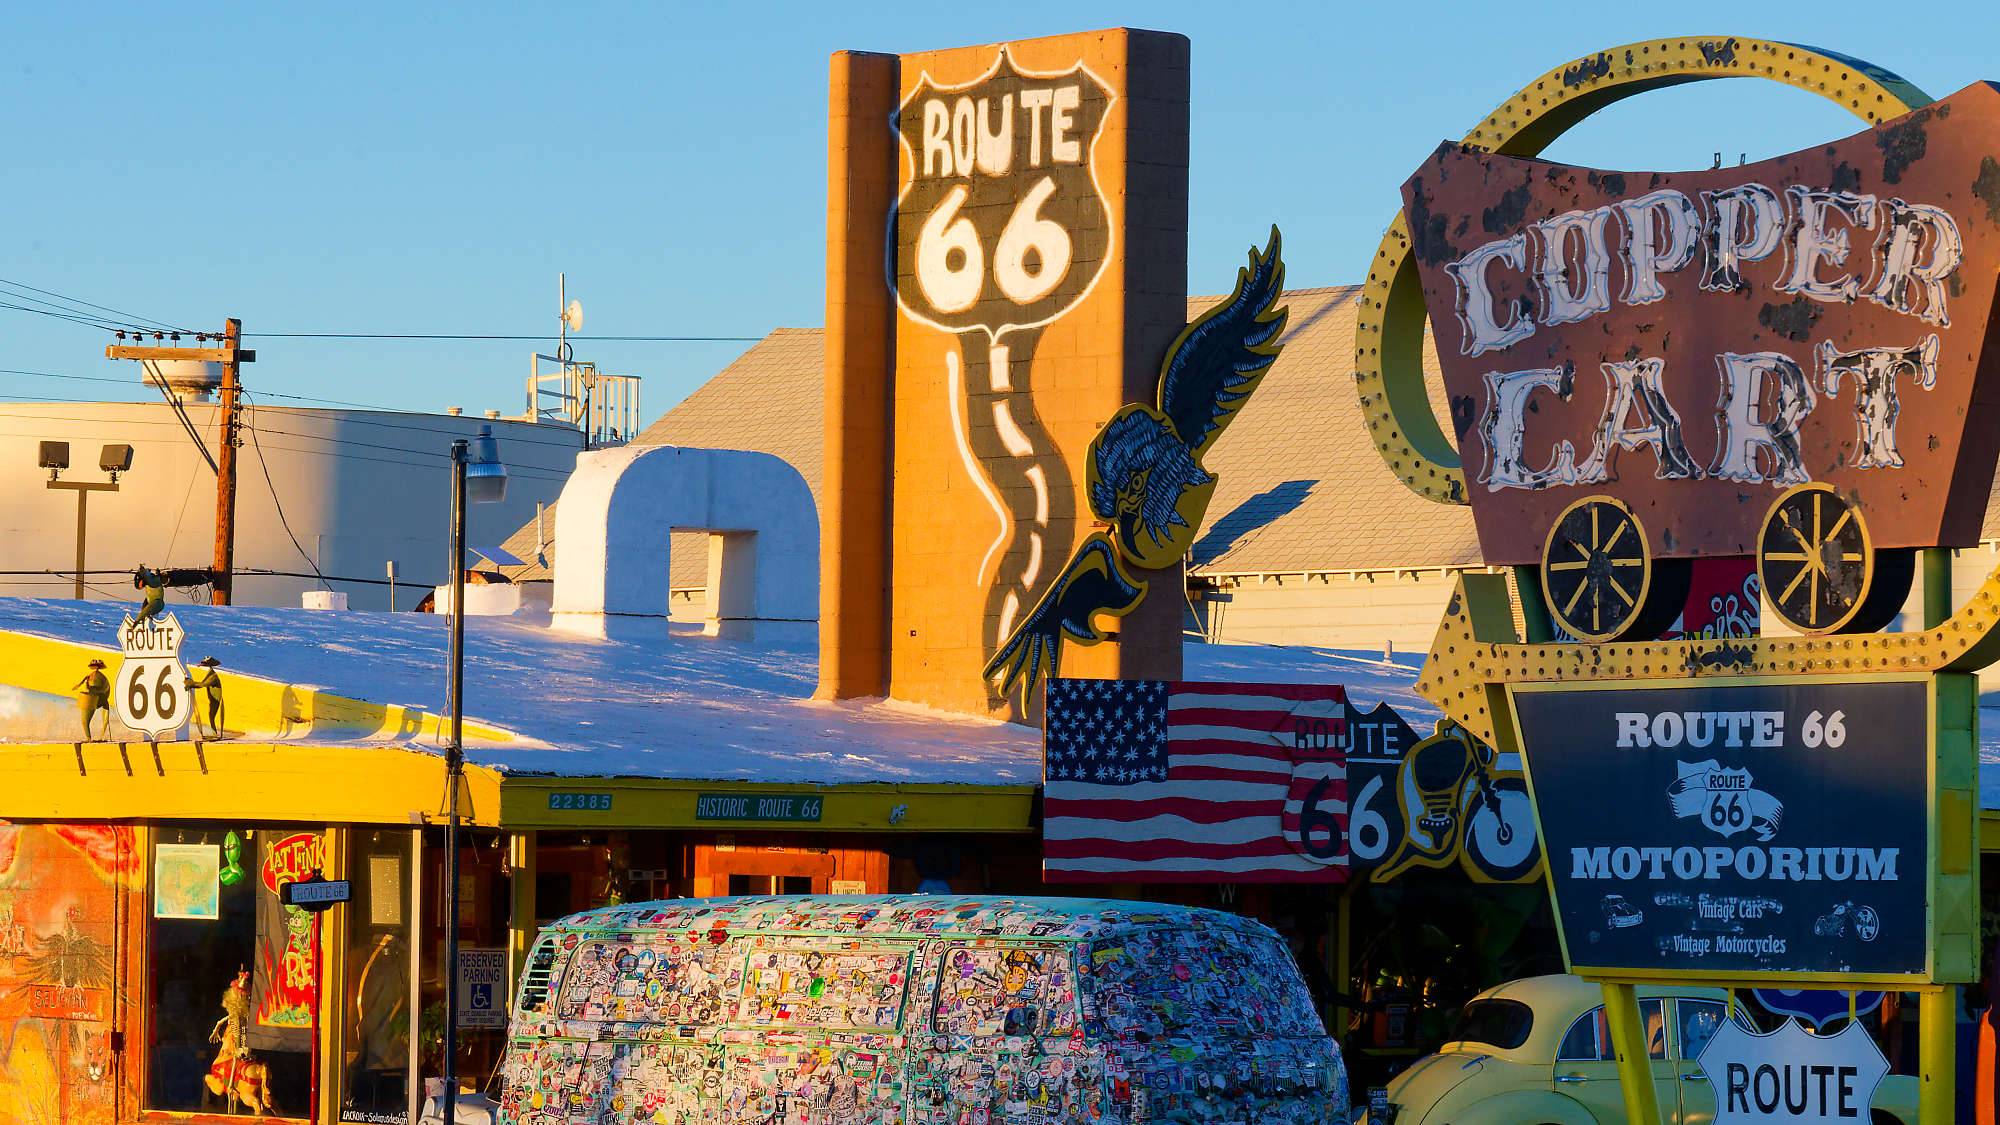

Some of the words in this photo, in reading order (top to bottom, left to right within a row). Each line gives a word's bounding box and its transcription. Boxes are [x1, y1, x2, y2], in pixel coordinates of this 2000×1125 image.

[923, 85, 1081, 178] ROUTE
[915, 175, 1074, 314] 66
[1443, 182, 1964, 358] COPPER
[1476, 333, 1940, 492] CART
[126, 627, 174, 651] ROUTE
[128, 664, 177, 720] 66
[1294, 719, 1400, 756] ROUTE
[1615, 711, 1785, 748] ROUTE
[1801, 709, 1846, 749] 66
[1709, 773, 1746, 789] ROUTE
[551, 794, 612, 810] 22385
[696, 797, 748, 817] HISTORIC
[758, 798, 792, 818] ROUTE
[801, 799, 820, 818] 66
[1299, 774, 1389, 860] 66
[1710, 792, 1745, 828] 66
[1570, 846, 1900, 882] MOTOPORIUM
[1697, 901, 1735, 923] Vintage
[1738, 900, 1764, 919] Cars
[460, 953, 504, 968] RESERVED
[1673, 934, 1711, 956] Vintage
[1715, 935, 1787, 957] Motorcycles
[463, 967, 500, 983] PARKING
[1726, 1062, 1858, 1118] ROUTE
